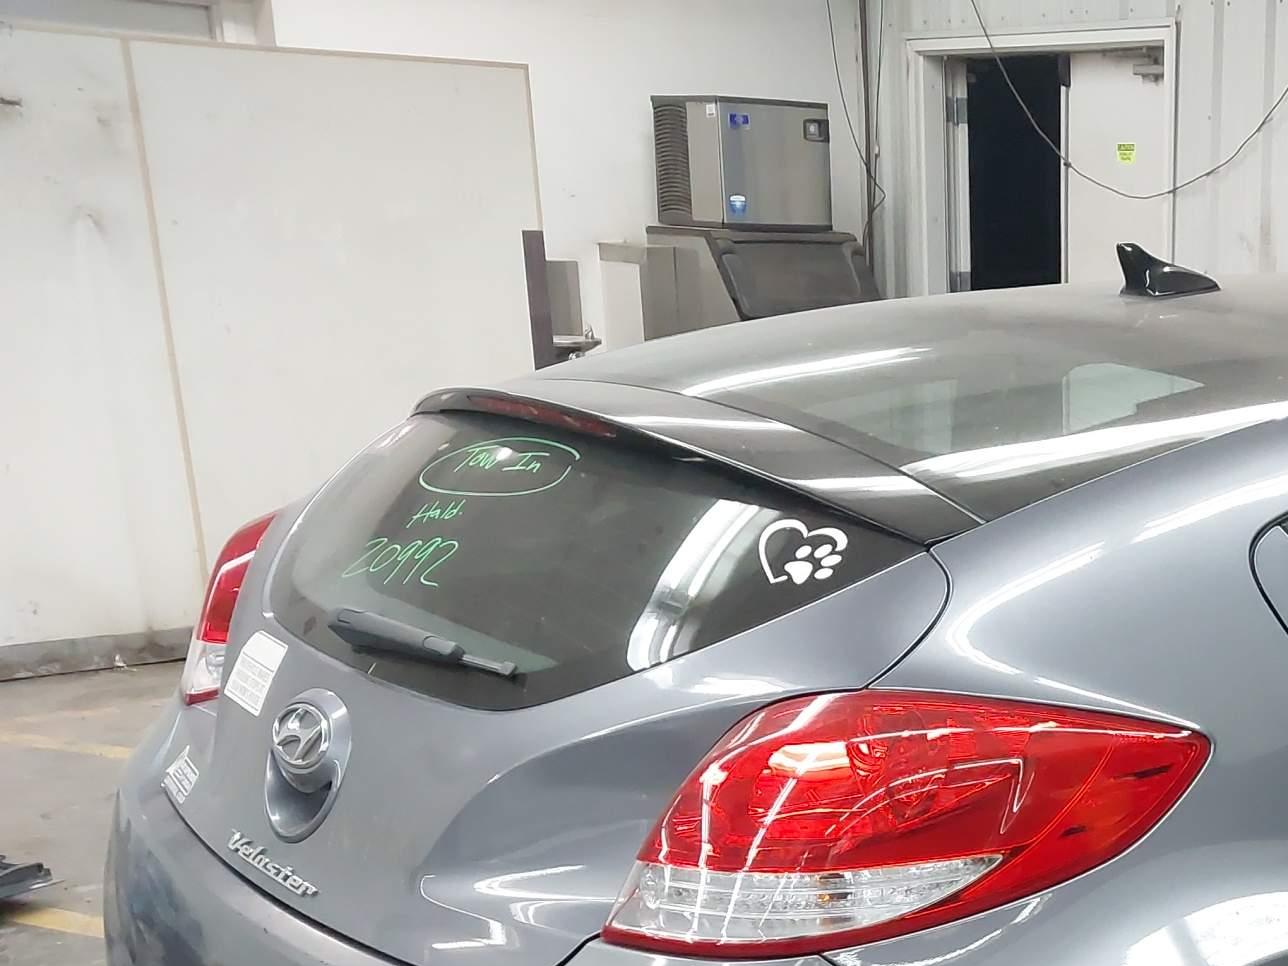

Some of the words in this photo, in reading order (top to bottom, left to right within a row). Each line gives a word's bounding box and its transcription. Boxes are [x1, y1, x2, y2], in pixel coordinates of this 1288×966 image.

[453, 444, 505, 473] Tow
[502, 451, 551, 473] In
[341, 537, 460, 588] 20992
